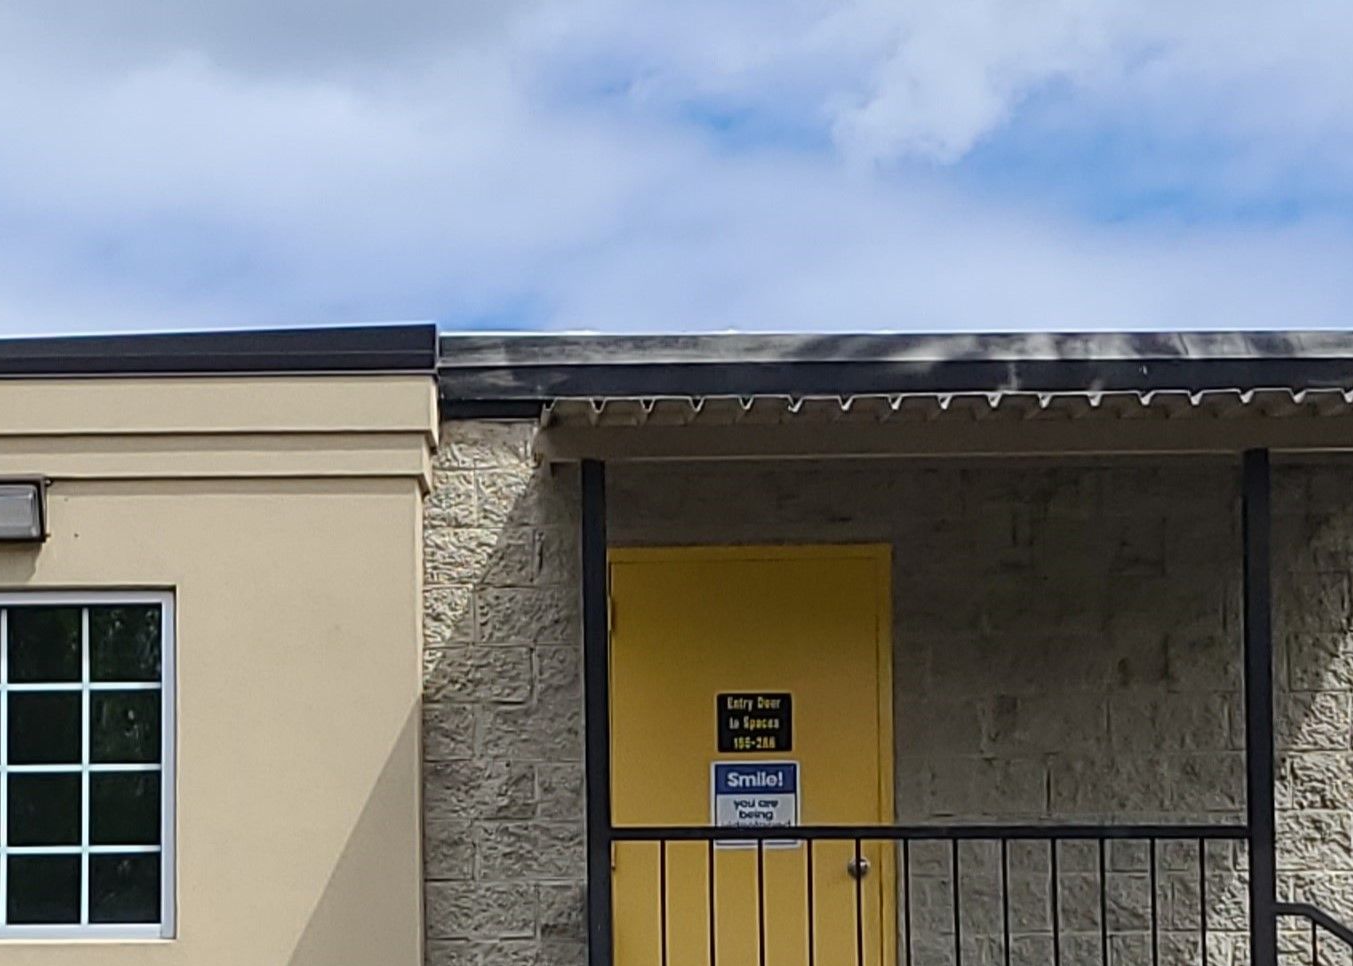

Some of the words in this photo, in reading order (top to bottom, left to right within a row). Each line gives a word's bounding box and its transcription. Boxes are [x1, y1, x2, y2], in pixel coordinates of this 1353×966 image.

[726, 696, 754, 712] Entry
[743, 714, 780, 732] Spaces
[726, 770, 784, 788] Smile!
[732, 799, 756, 811] you
[758, 799, 779, 809] are
[739, 809, 775, 821] being
